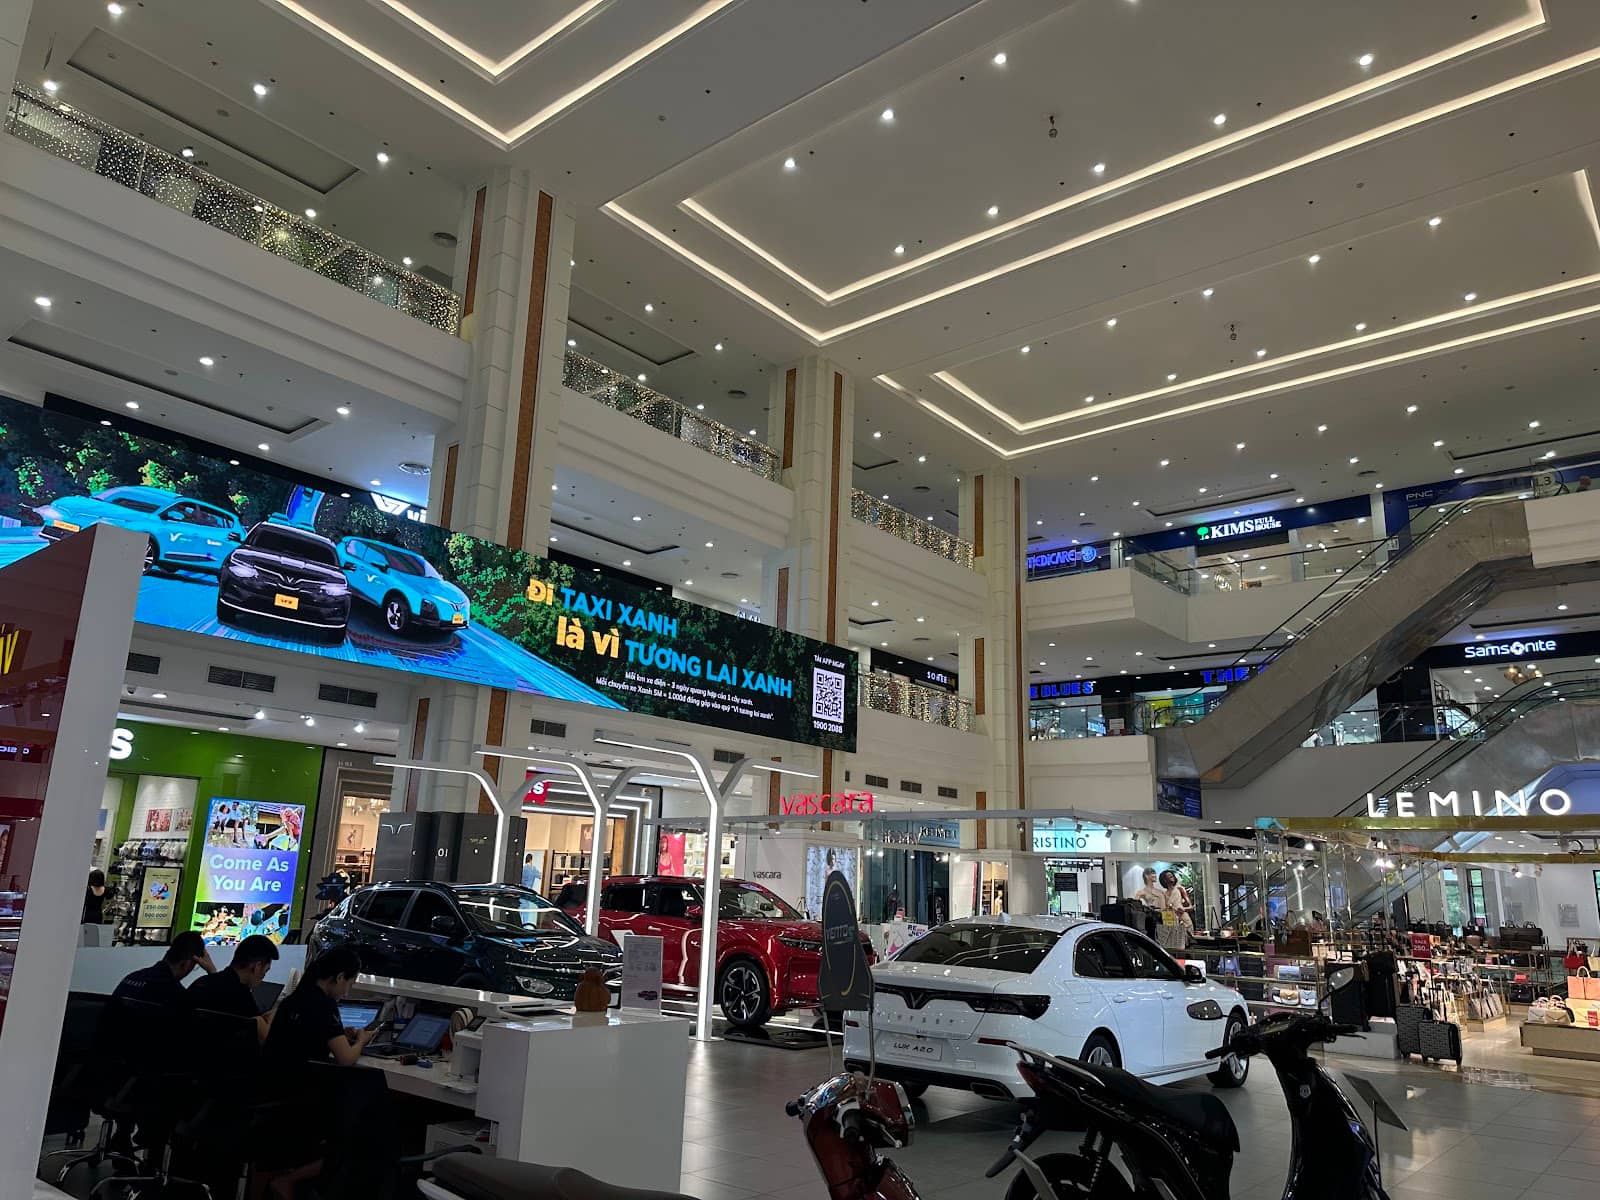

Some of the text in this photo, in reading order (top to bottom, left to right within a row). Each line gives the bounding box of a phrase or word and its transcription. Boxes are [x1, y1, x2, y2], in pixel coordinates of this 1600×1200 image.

[1210, 520, 1254, 539] KIMS
[560, 586, 612, 621] TAXI
[617, 603, 678, 638] XANH
[556, 616, 792, 699] là vì TƯƠNG LAI XANH
[1464, 639, 1556, 658] Samsonite
[1040, 681, 1094, 697] BLUES
[780, 791, 874, 816] vascara
[1366, 788, 1572, 818] LEMINO
[210, 853, 289, 872] Come As
[213, 874, 282, 892] You Are
[753, 871, 782, 880] vascara
